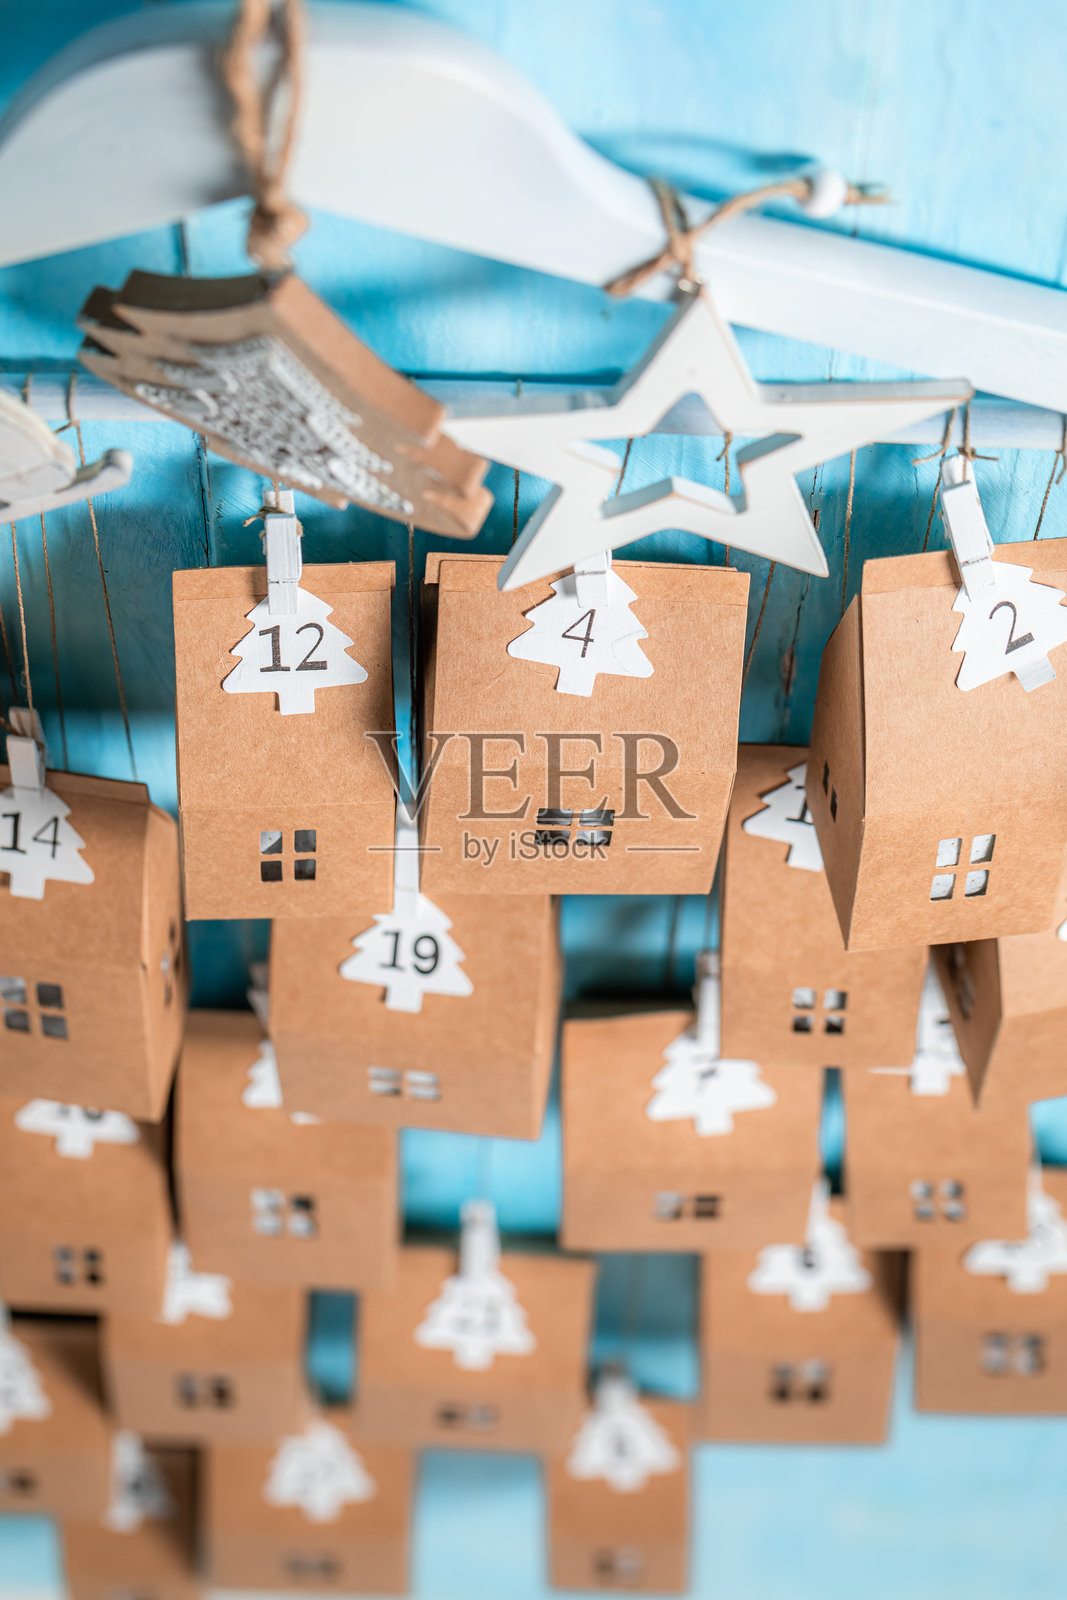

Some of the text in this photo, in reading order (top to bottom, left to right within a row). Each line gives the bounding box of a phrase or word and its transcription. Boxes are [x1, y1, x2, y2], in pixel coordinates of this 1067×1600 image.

[258, 622, 328, 673] 12
[561, 608, 596, 659] 4
[988, 600, 1035, 656] 2
[1, 811, 61, 859] 14
[379, 930, 440, 975] 19
